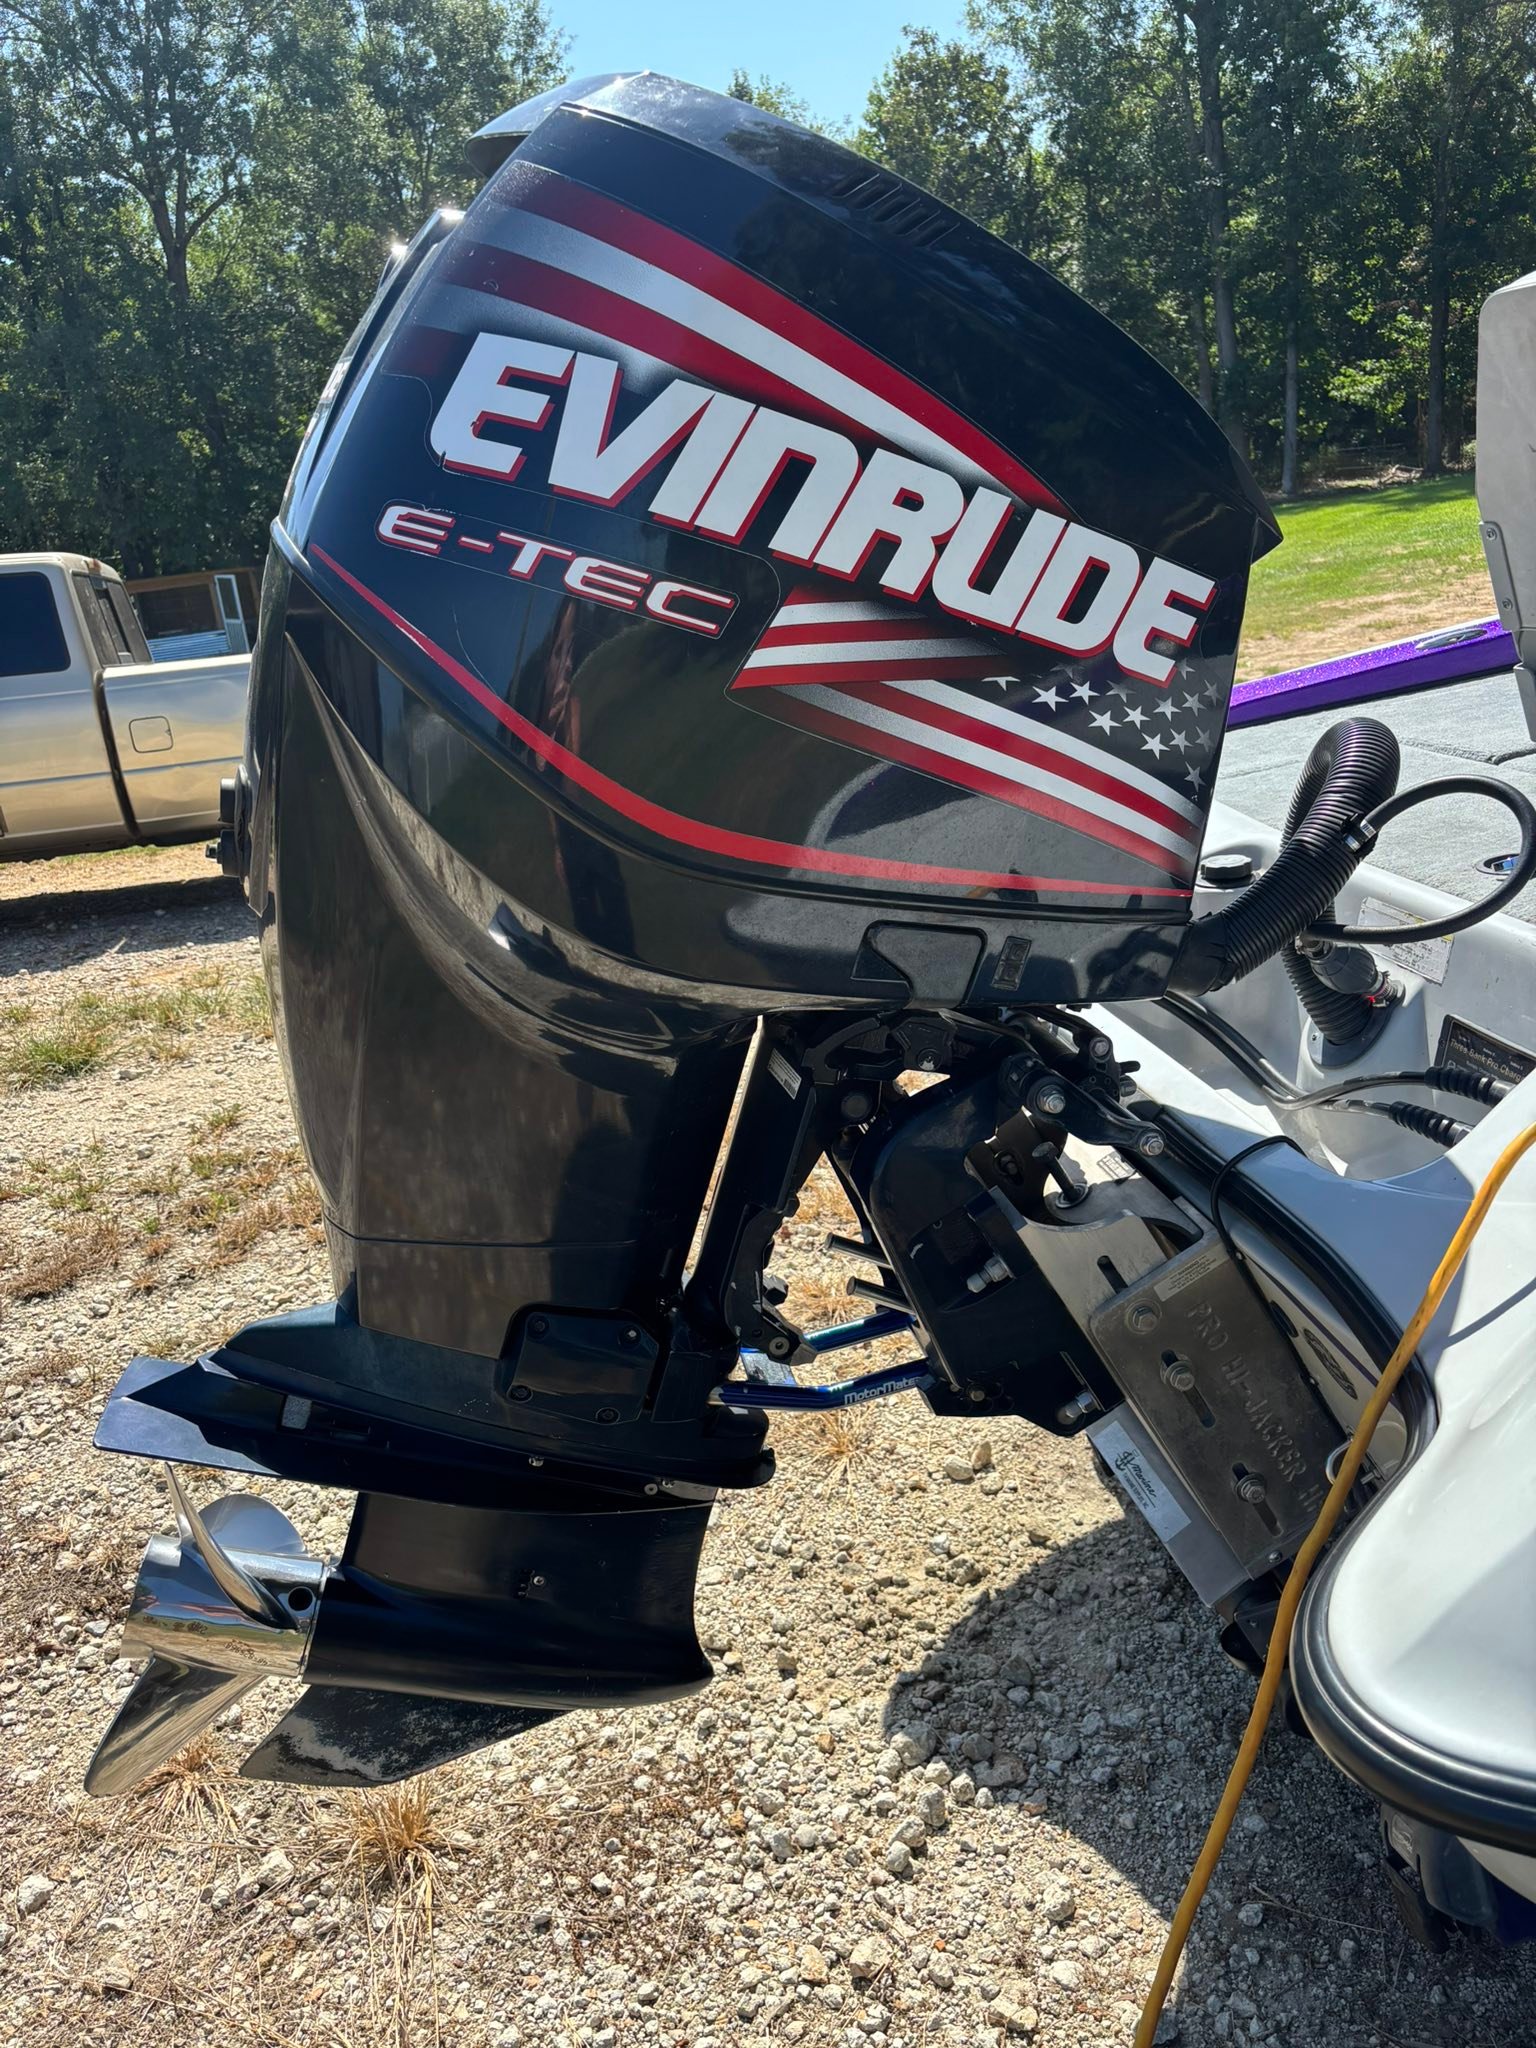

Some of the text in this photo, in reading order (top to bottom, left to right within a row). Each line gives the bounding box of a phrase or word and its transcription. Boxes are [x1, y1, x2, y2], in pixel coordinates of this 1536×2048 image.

[377, 504, 735, 635] E-TEC
[429, 331, 1217, 688] EVINRUDE
[1450, 1038, 1467, 1054] Three
[1469, 1048, 1485, 1064] Bank
[1500, 1064, 1522, 1082] Charg
[844, 1377, 917, 1405] MotorMate
[1187, 1301, 1229, 1350] PRO
[1221, 1354, 1307, 1482] HI-JACKER
